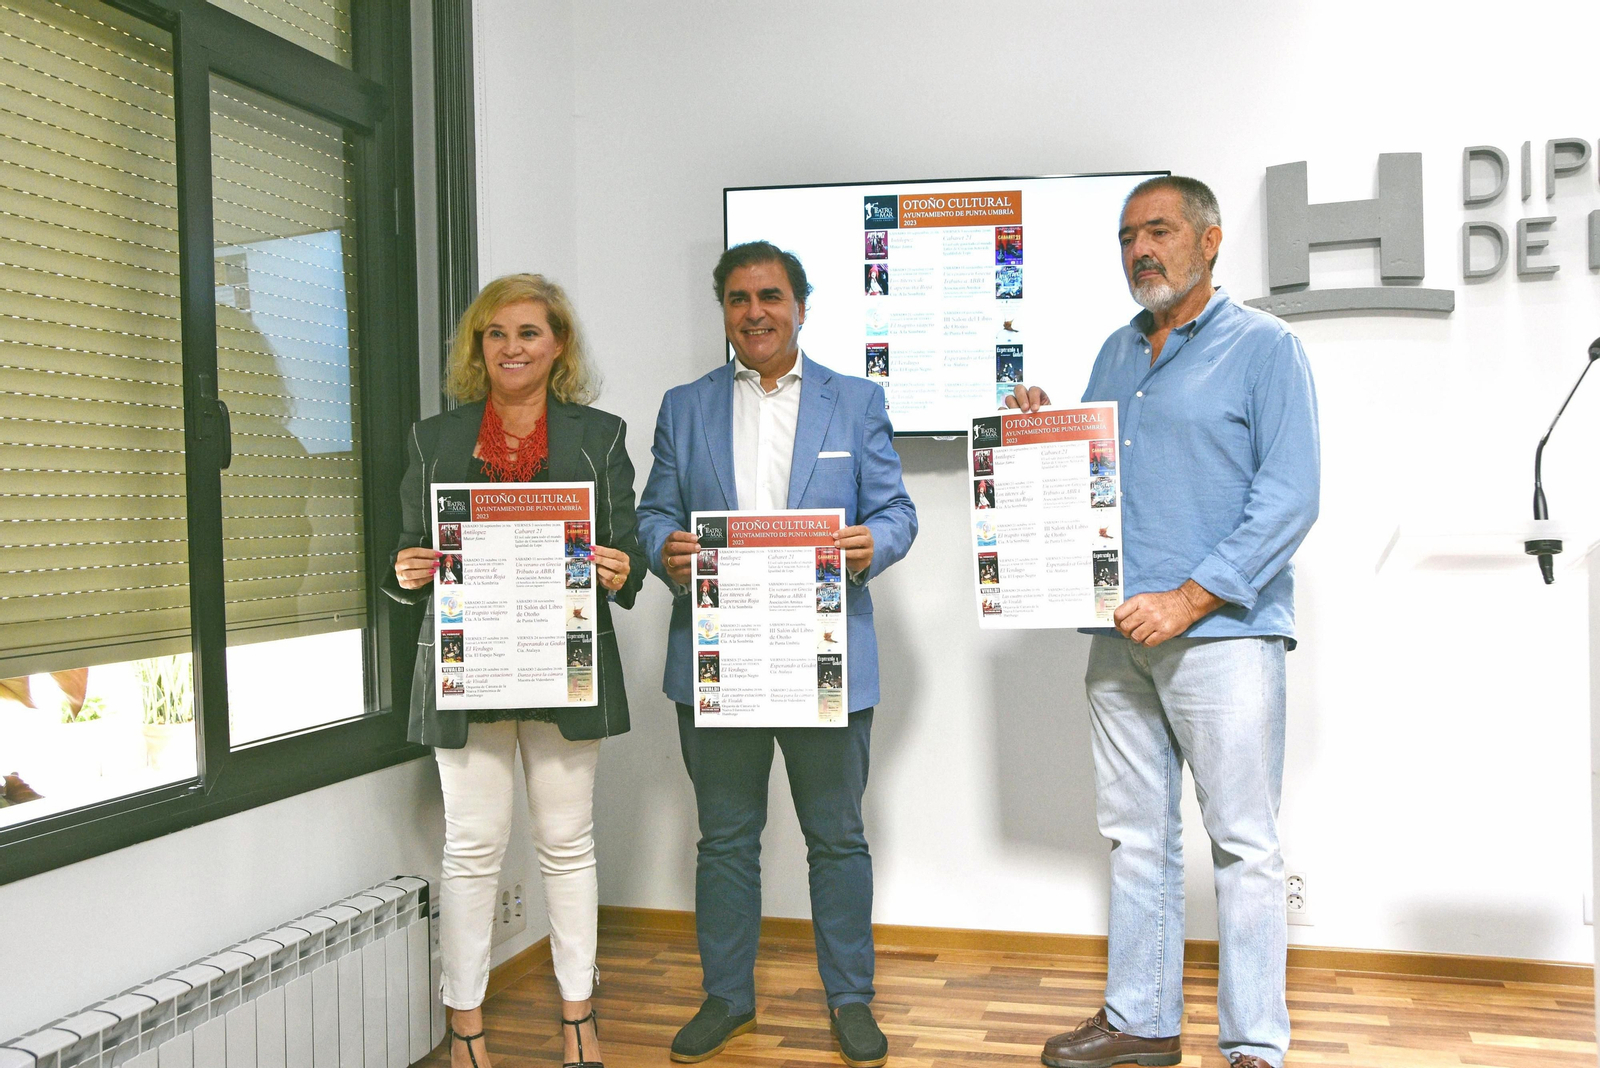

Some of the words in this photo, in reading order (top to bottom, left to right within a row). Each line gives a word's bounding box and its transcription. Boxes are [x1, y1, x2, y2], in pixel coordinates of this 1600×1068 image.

[1463, 137, 1600, 206] DIP
[902, 197, 945, 210] OTOÑO
[947, 196, 1012, 209] CULTURAL
[902, 210, 954, 218] AYUNTAMIENTO
[987, 207, 1015, 215] UMBRÍA
[1266, 152, 1425, 291] H
[1463, 216, 1560, 279] DE
[1005, 417, 1042, 429] OTOÑO
[1044, 413, 1103, 426] CULTURAL
[1005, 428, 1051, 436] AYUNTAMIENTO
[1081, 423, 1107, 431] UMBRÍA
[475, 492, 516, 504] OTOÑO
[518, 494, 580, 504] CULTURAL
[731, 519, 770, 531] OTOÑO
[772, 520, 831, 530] CULTURAL
